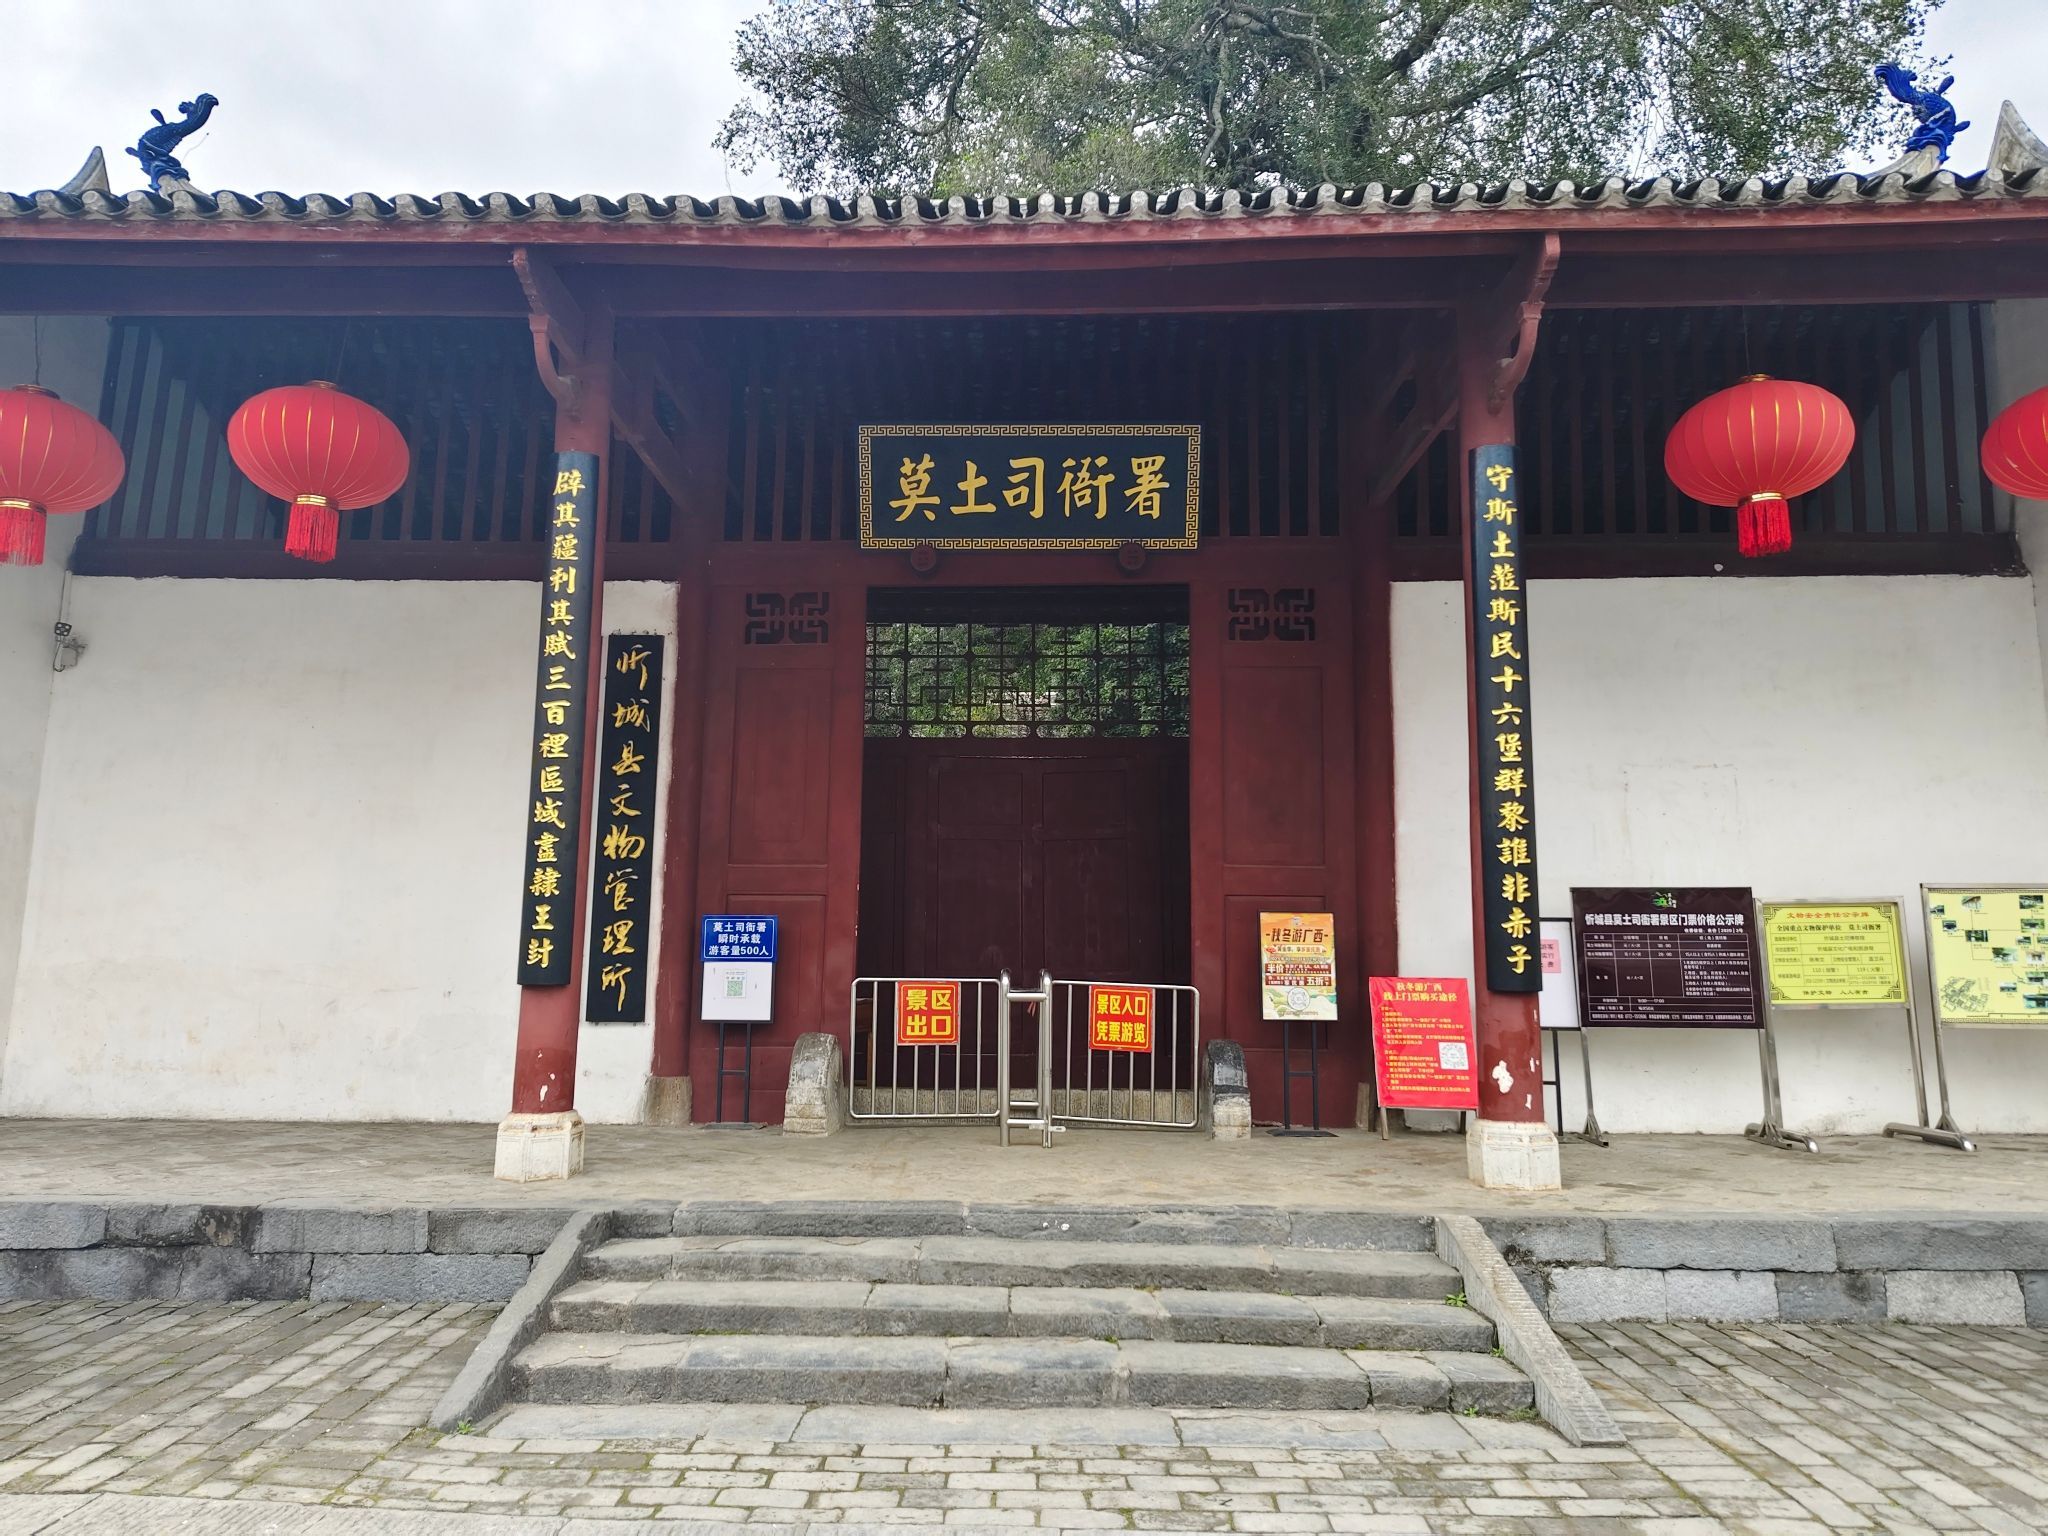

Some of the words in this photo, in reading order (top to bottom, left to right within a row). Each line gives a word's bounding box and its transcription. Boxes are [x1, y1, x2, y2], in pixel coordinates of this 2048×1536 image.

[888, 453, 1171, 522] 莫土司衙署
[601, 643, 653, 1012] 忻城县文物管理所
[713, 921, 767, 932] 莫土司衙署
[1584, 913, 1745, 927] 忻城县莫土司衙署景区门票价格公示牌
[717, 933, 761, 944] 瞬时承载
[1271, 928, 1325, 943] 秋冬游广西
[708, 945, 769, 956] 游客量500人
[905, 989, 952, 1011] 景区
[1096, 994, 1146, 1015] 景区入口
[905, 1014, 952, 1037] 出口
[1096, 1020, 1146, 1043] 凭票游览
